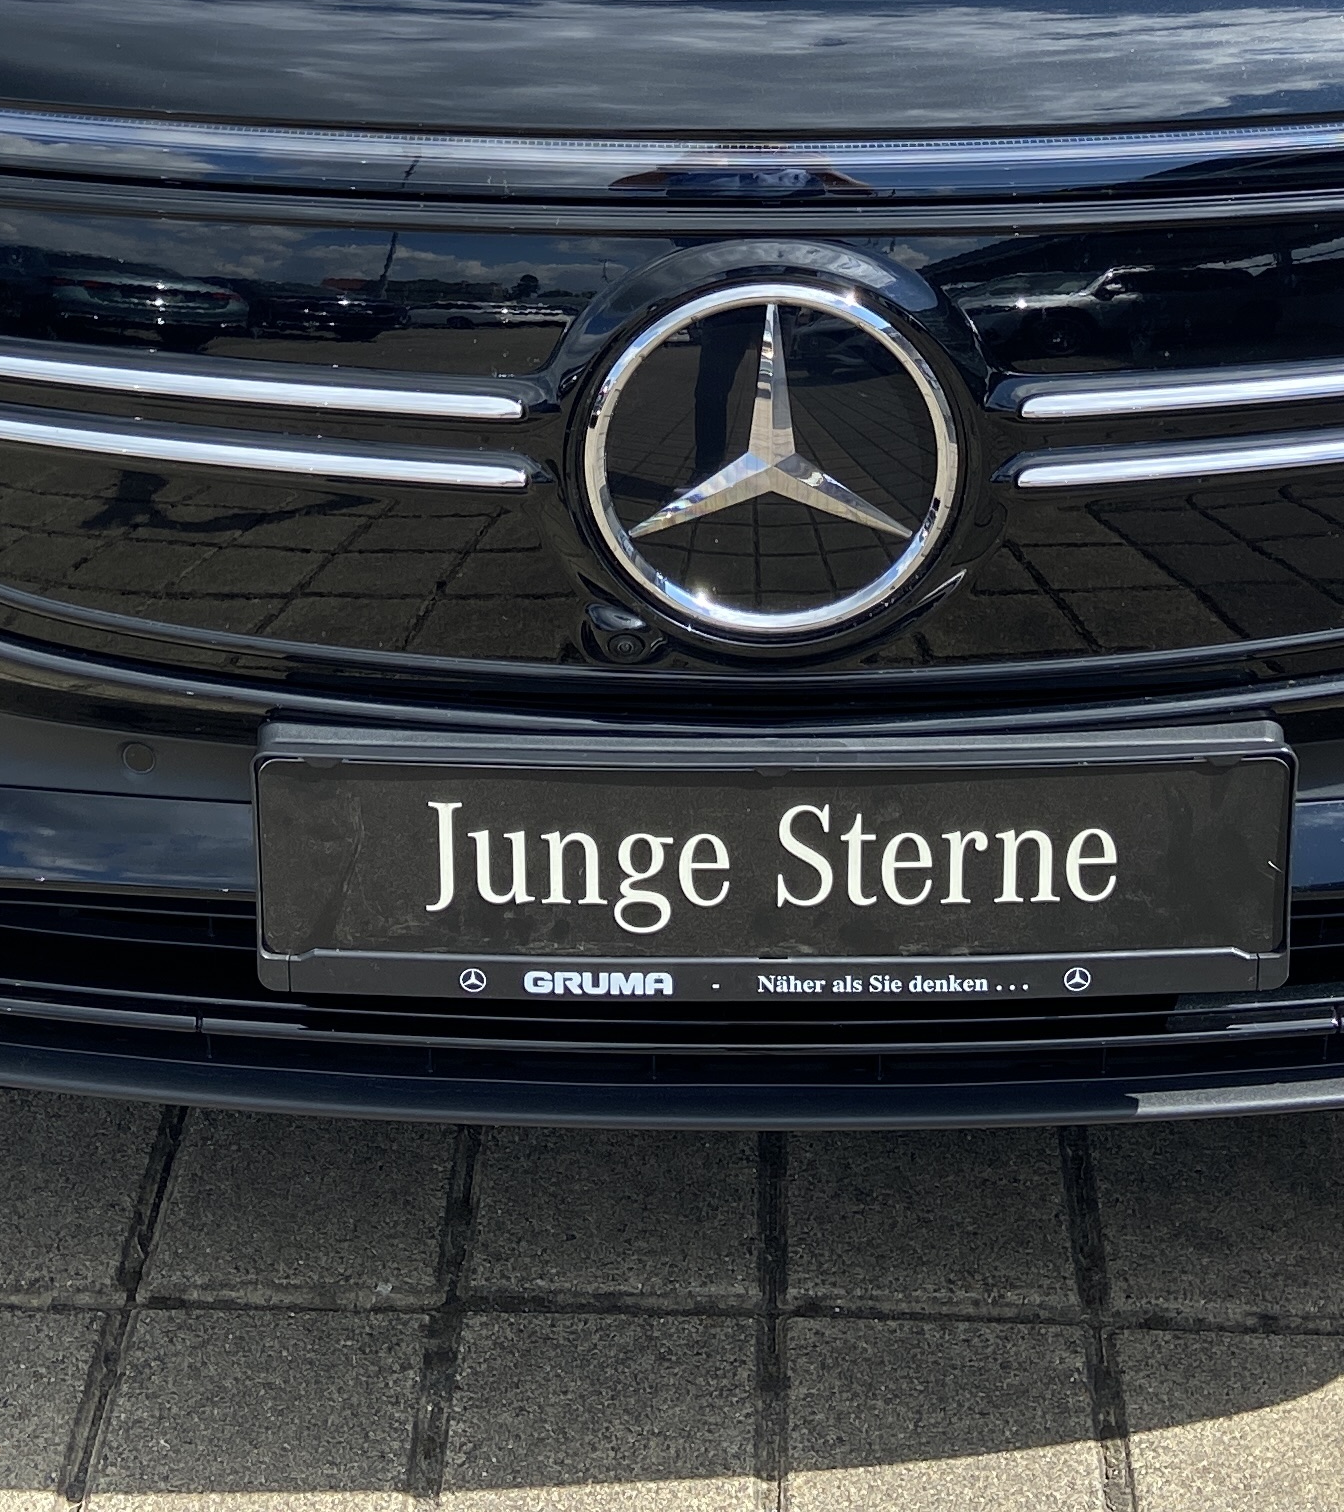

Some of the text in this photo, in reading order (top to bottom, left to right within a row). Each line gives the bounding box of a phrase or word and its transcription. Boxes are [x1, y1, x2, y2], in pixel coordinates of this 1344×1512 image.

[425, 801, 1117, 934] Junge Sterne
[523, 970, 673, 996] GRUMA
[757, 974, 826, 993] Näher
[832, 974, 863, 993] als
[868, 974, 903, 993] Sie
[908, 974, 989, 993] denken
